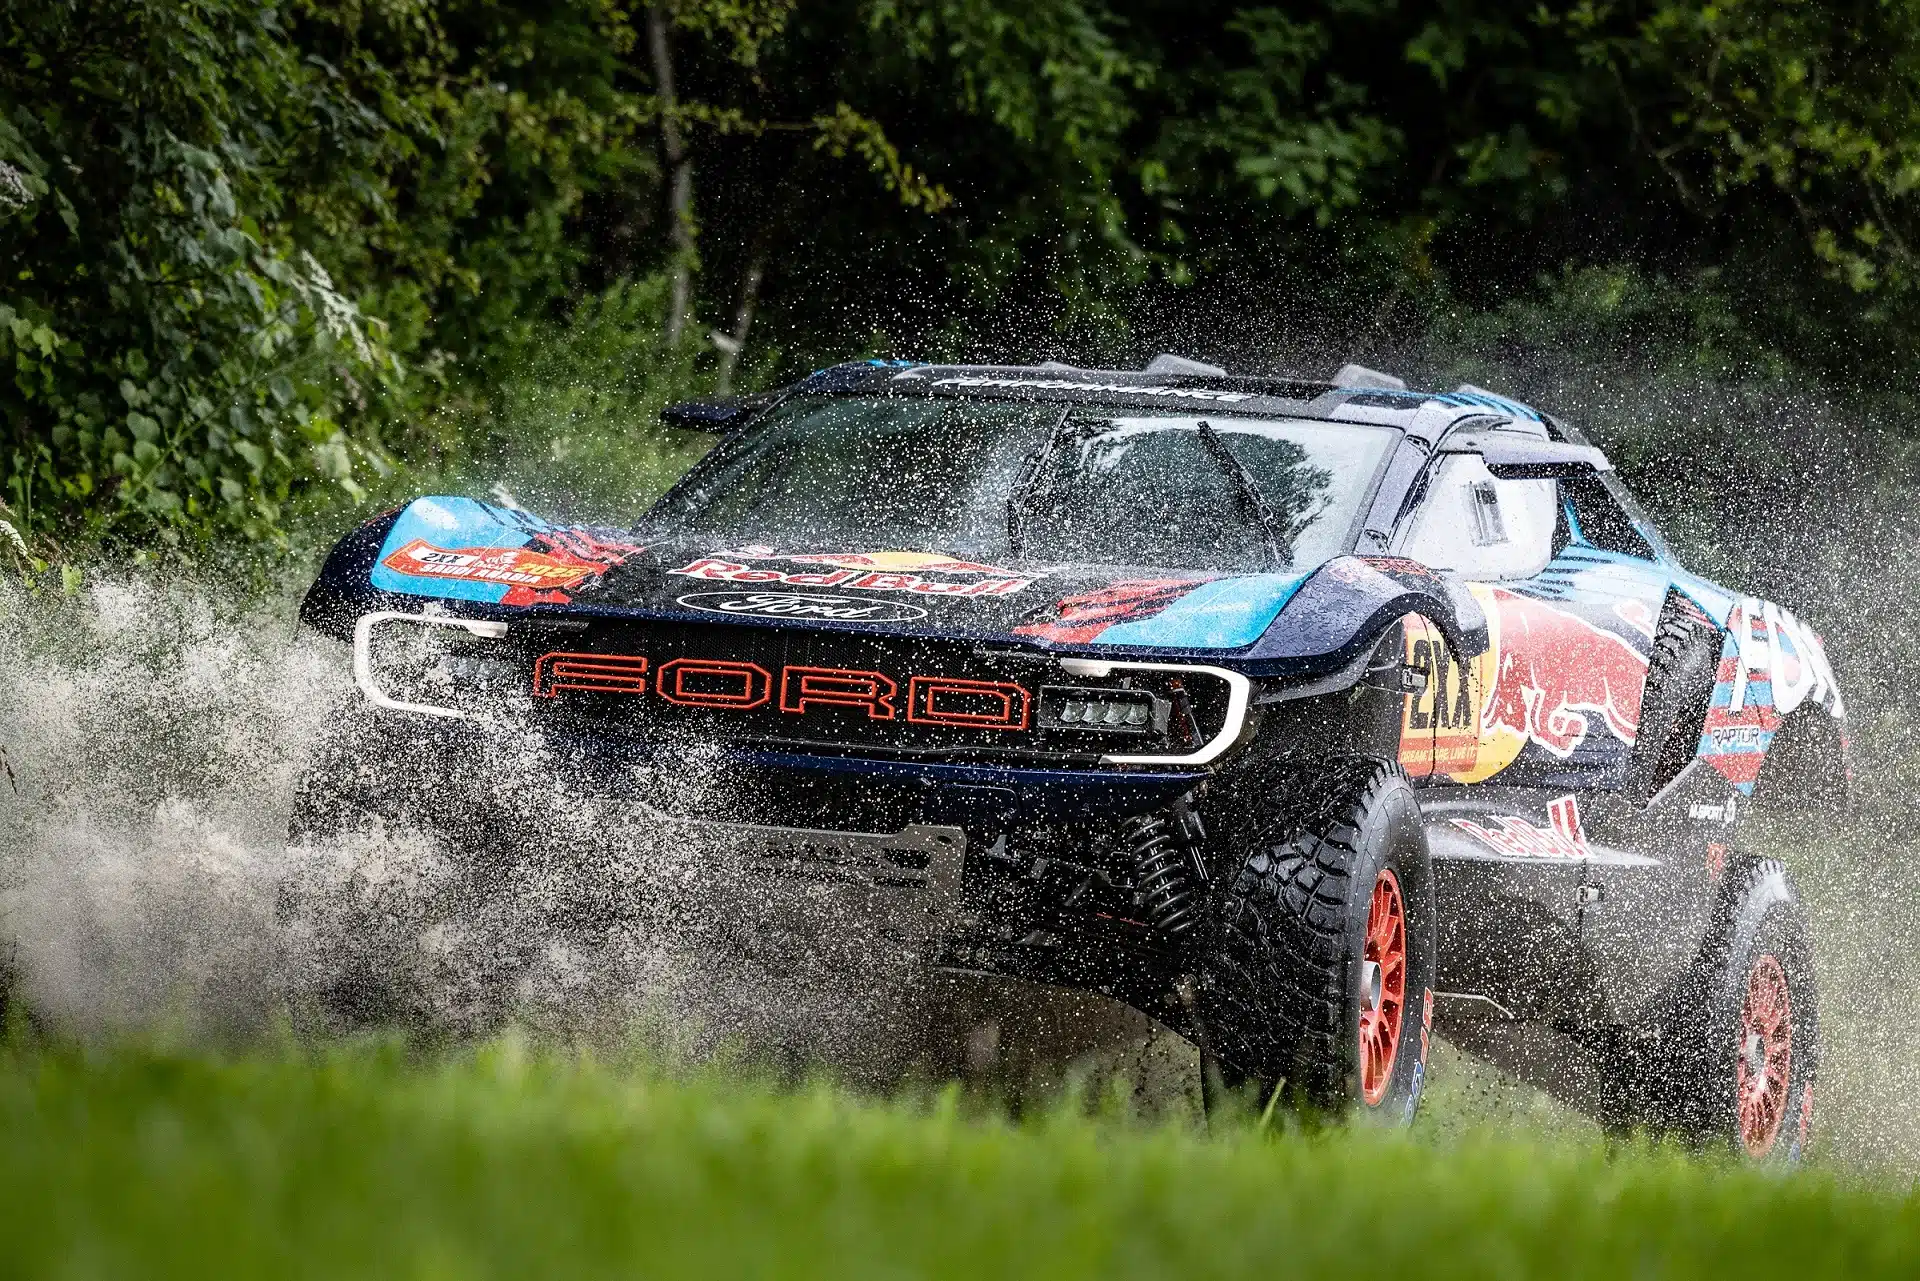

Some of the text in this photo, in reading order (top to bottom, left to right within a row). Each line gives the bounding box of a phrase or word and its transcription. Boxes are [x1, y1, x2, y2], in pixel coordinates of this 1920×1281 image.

[422, 552, 464, 563] 2XX
[420, 564, 541, 583] SAUDI ARABIA
[514, 563, 581, 578] 2025
[667, 559, 1033, 596] Red Bull
[719, 594, 884, 618] Ford
[534, 652, 1031, 730] FORD
[1410, 640, 1471, 729] 2XX
[1712, 727, 1760, 746] RAPTOR
